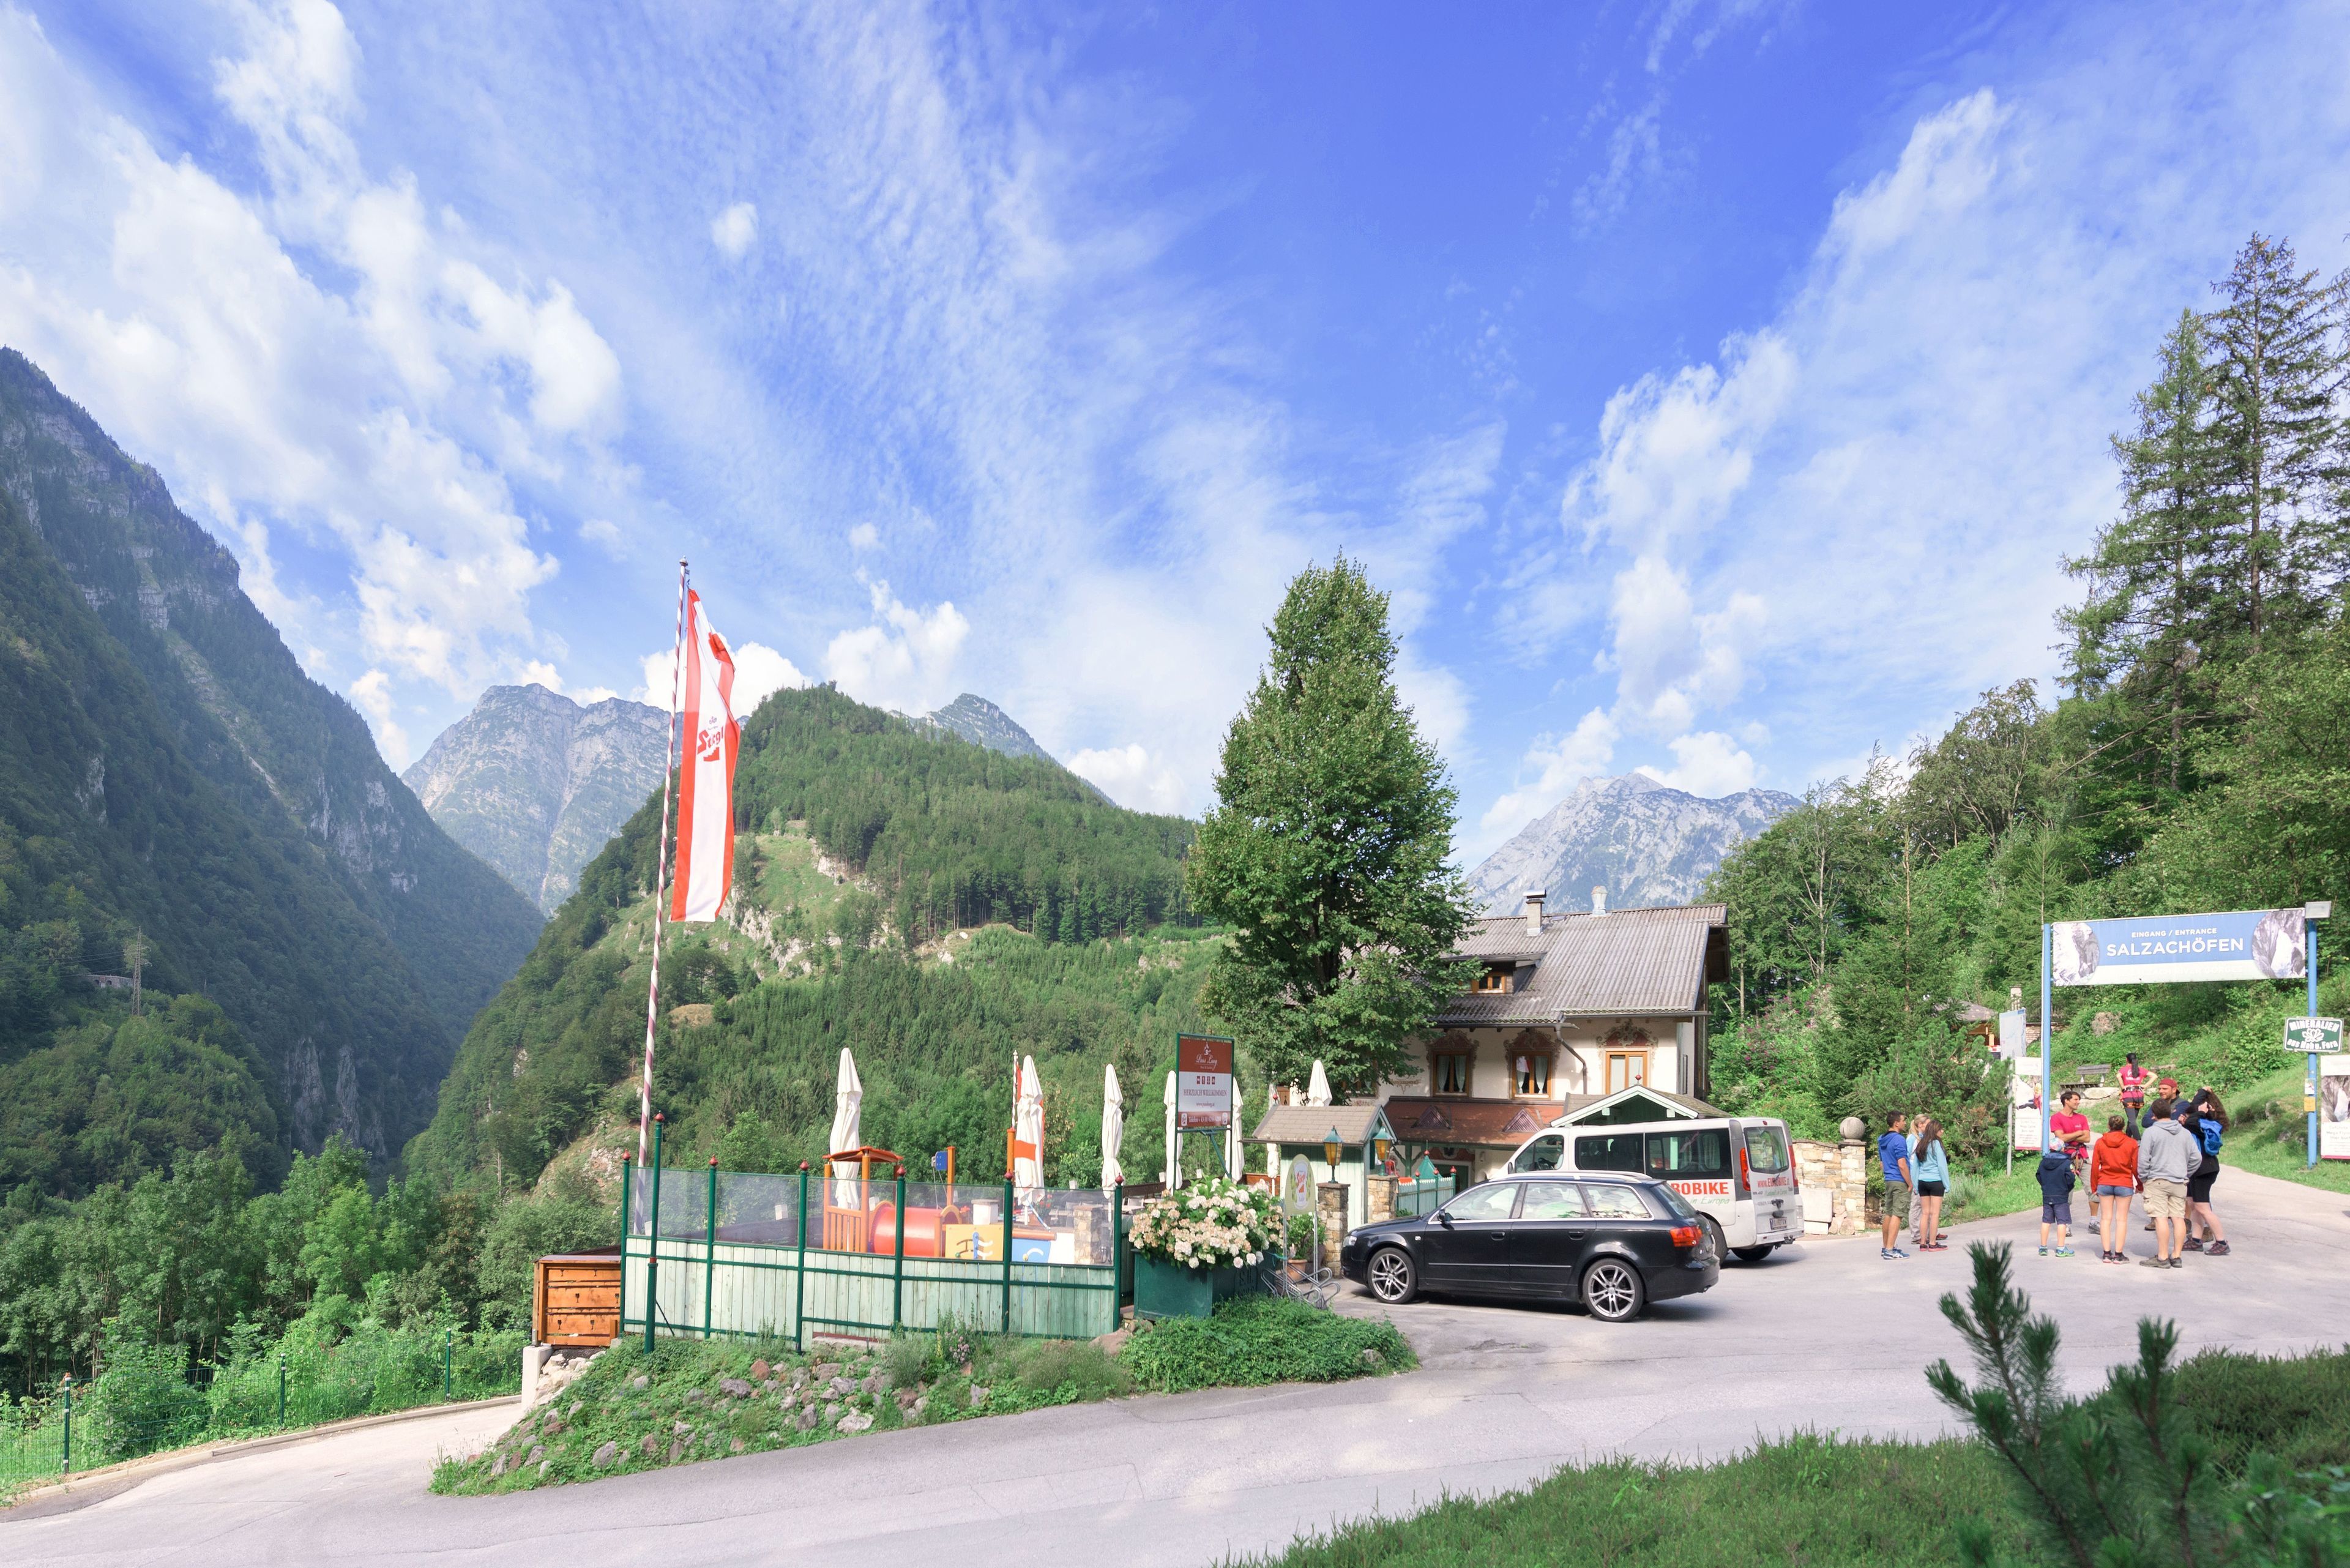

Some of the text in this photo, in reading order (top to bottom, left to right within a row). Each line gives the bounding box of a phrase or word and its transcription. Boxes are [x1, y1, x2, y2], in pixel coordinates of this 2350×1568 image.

[2106, 937, 2244, 957] SALZACHÖFEN
[2289, 1020, 2340, 1032] MINERALIEN
[1701, 1196, 1730, 1206] Europa
